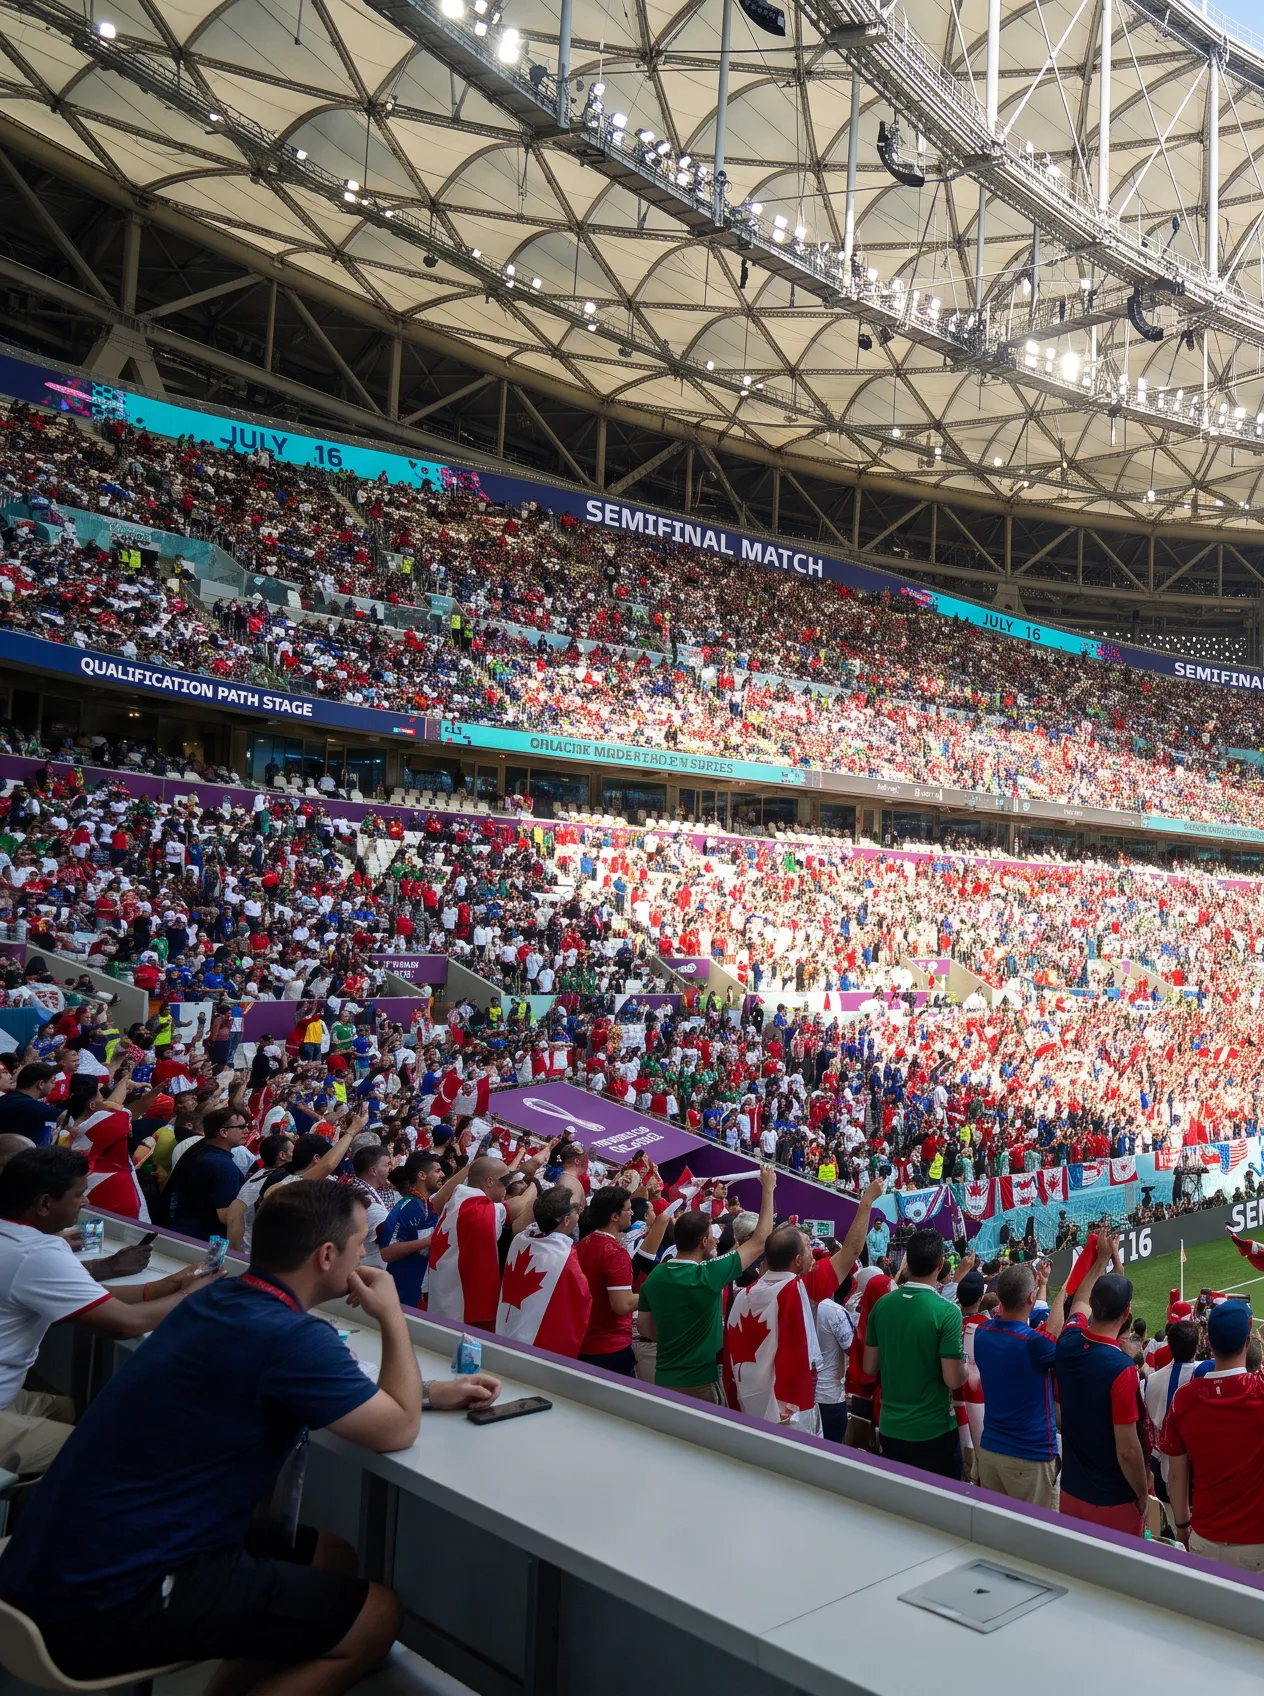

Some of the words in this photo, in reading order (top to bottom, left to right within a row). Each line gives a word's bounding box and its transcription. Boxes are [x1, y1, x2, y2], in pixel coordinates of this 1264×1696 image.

[220, 426, 288, 456] JULY
[314, 445, 343, 467] 16
[586, 500, 734, 555] SEMIFINAL
[741, 539, 823, 578] MATCH
[982, 613, 1014, 632] JULY
[1025, 626, 1041, 640] 16
[80, 657, 213, 698] QUALIFICATION
[217, 686, 259, 707] PATH
[262, 696, 313, 717] STAGE
[1129, 1227, 1152, 1262] 16
